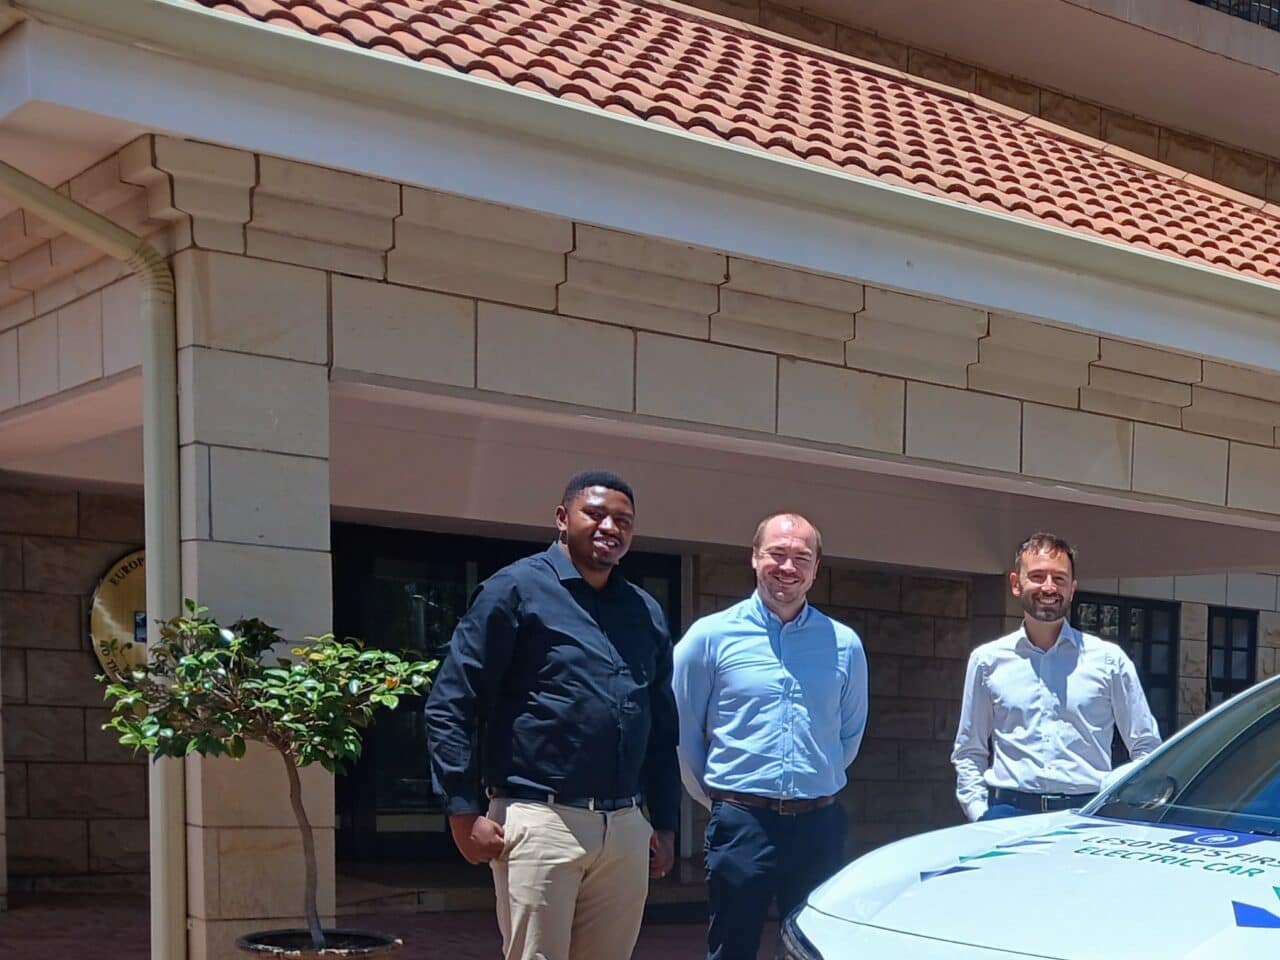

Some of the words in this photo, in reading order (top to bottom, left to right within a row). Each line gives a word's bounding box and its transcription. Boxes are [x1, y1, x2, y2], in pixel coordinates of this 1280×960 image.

[1082, 836, 1225, 858] LESOTHO'S
[1073, 845, 1206, 868] ELECTRIC
[1202, 861, 1266, 878] CAR
